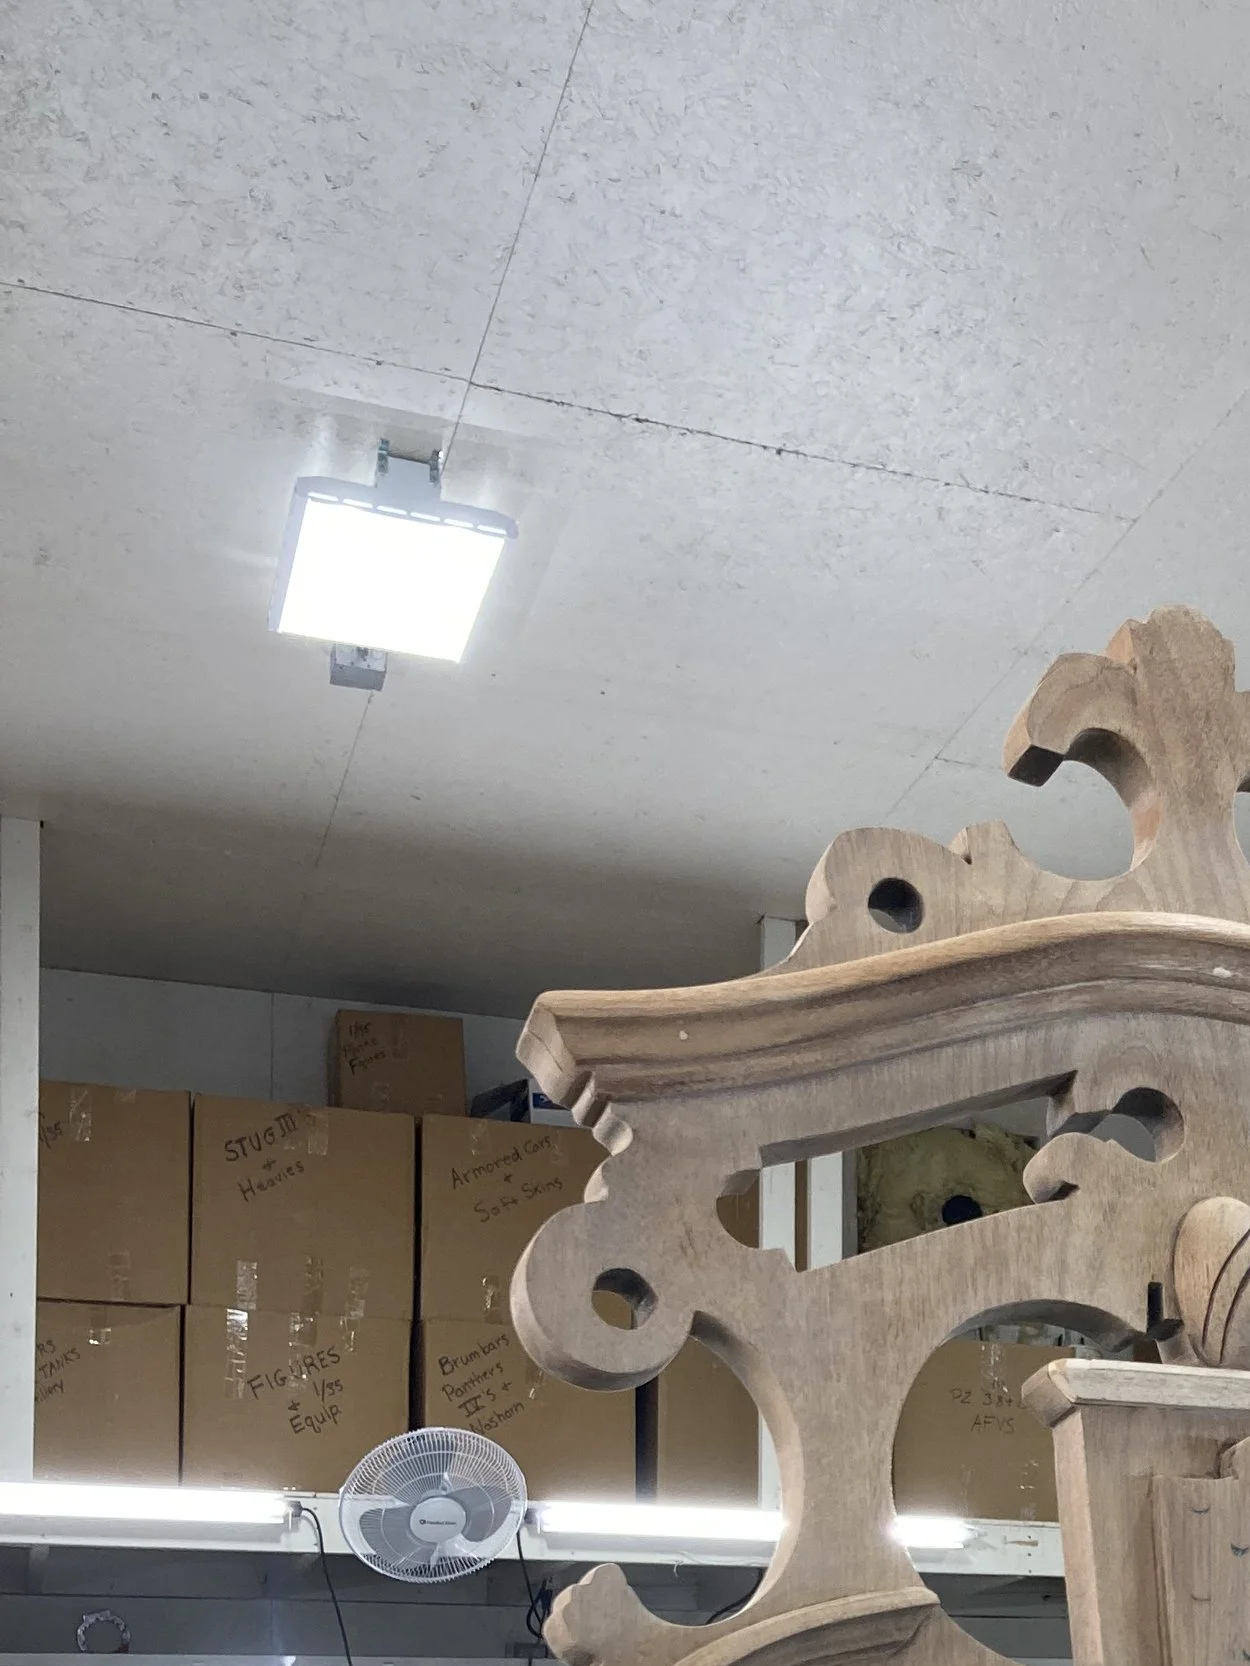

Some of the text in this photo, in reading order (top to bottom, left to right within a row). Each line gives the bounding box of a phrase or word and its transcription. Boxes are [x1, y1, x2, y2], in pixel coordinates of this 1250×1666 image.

[224, 1126, 275, 1162] STUG
[238, 1160, 304, 1202] Heavies
[450, 1146, 523, 1190] Armored
[247, 1346, 340, 1400] FIGURES
[442, 1362, 504, 1402] Panthers
